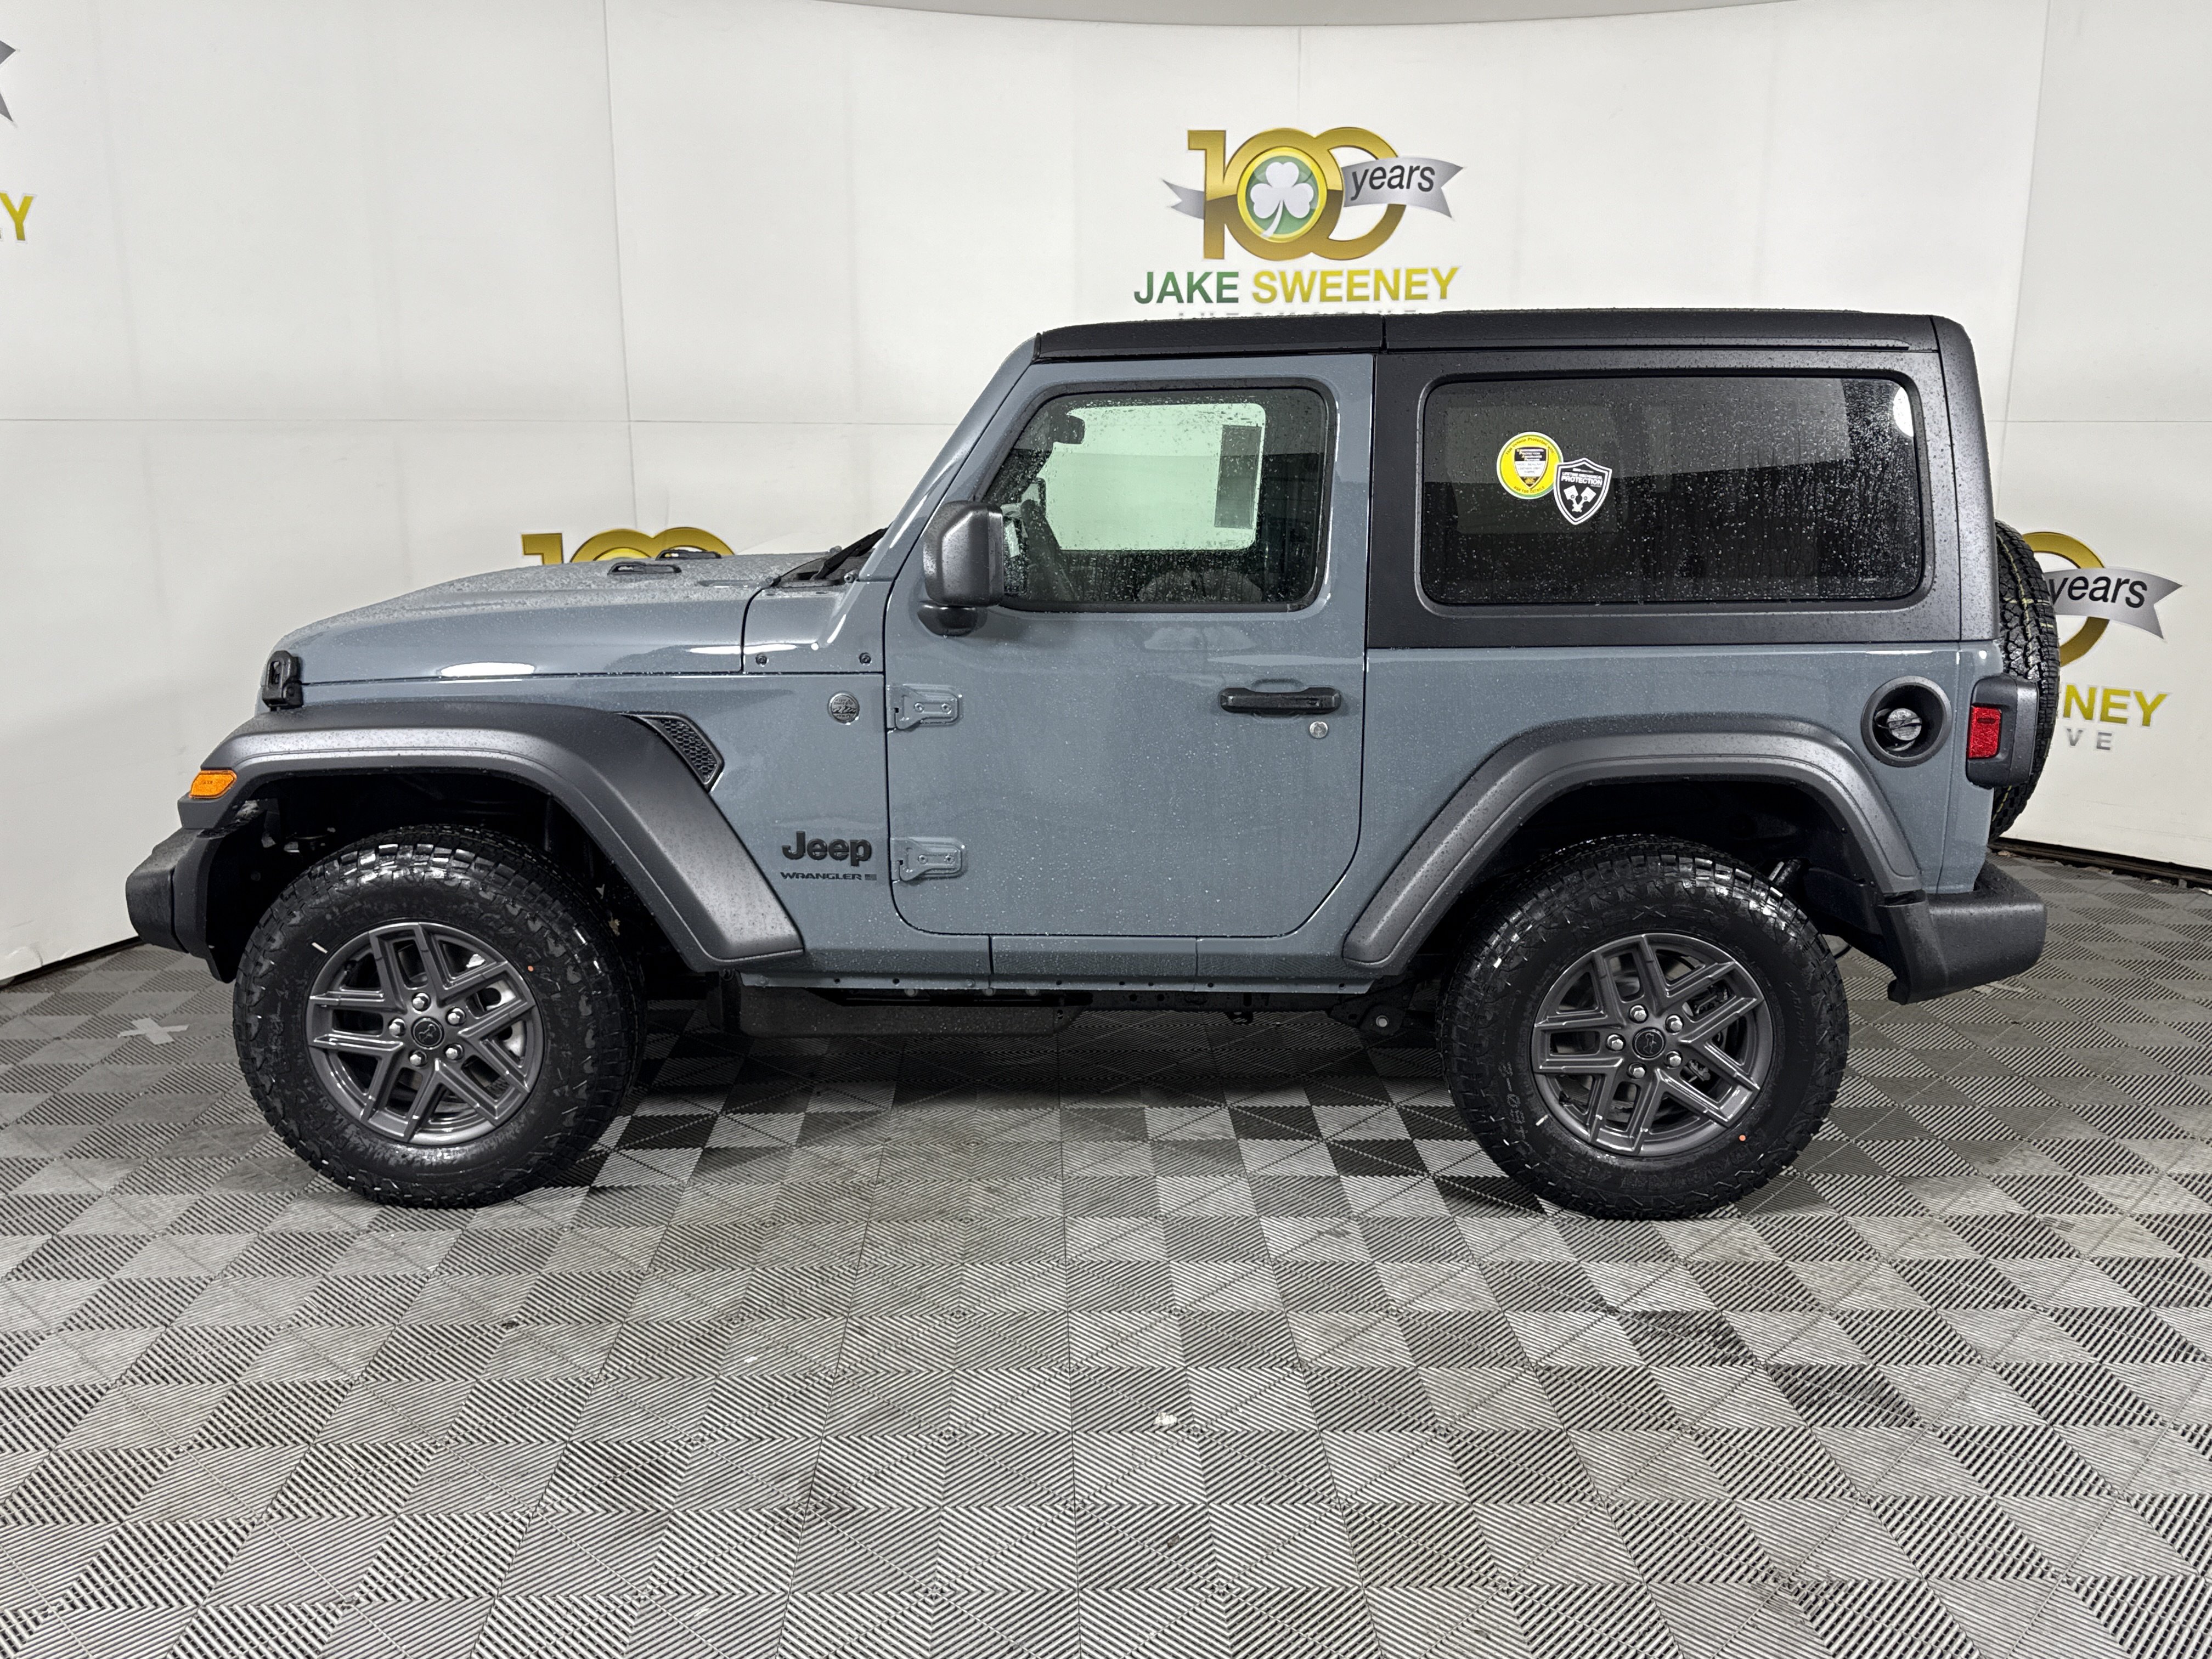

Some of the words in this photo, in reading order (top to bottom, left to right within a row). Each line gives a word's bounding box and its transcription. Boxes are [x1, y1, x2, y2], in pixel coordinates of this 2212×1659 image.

[1188, 127, 1407, 261] 100
[1350, 165, 1435, 201] years
[1133, 271, 1240, 304] JAKE
[1251, 267, 1460, 304] SWEENEY
[1561, 476, 1603, 486] PROTECTION
[2049, 575, 2148, 608] years
[782, 831, 872, 867] Jeep
[780, 872, 862, 880] WRANGLER
